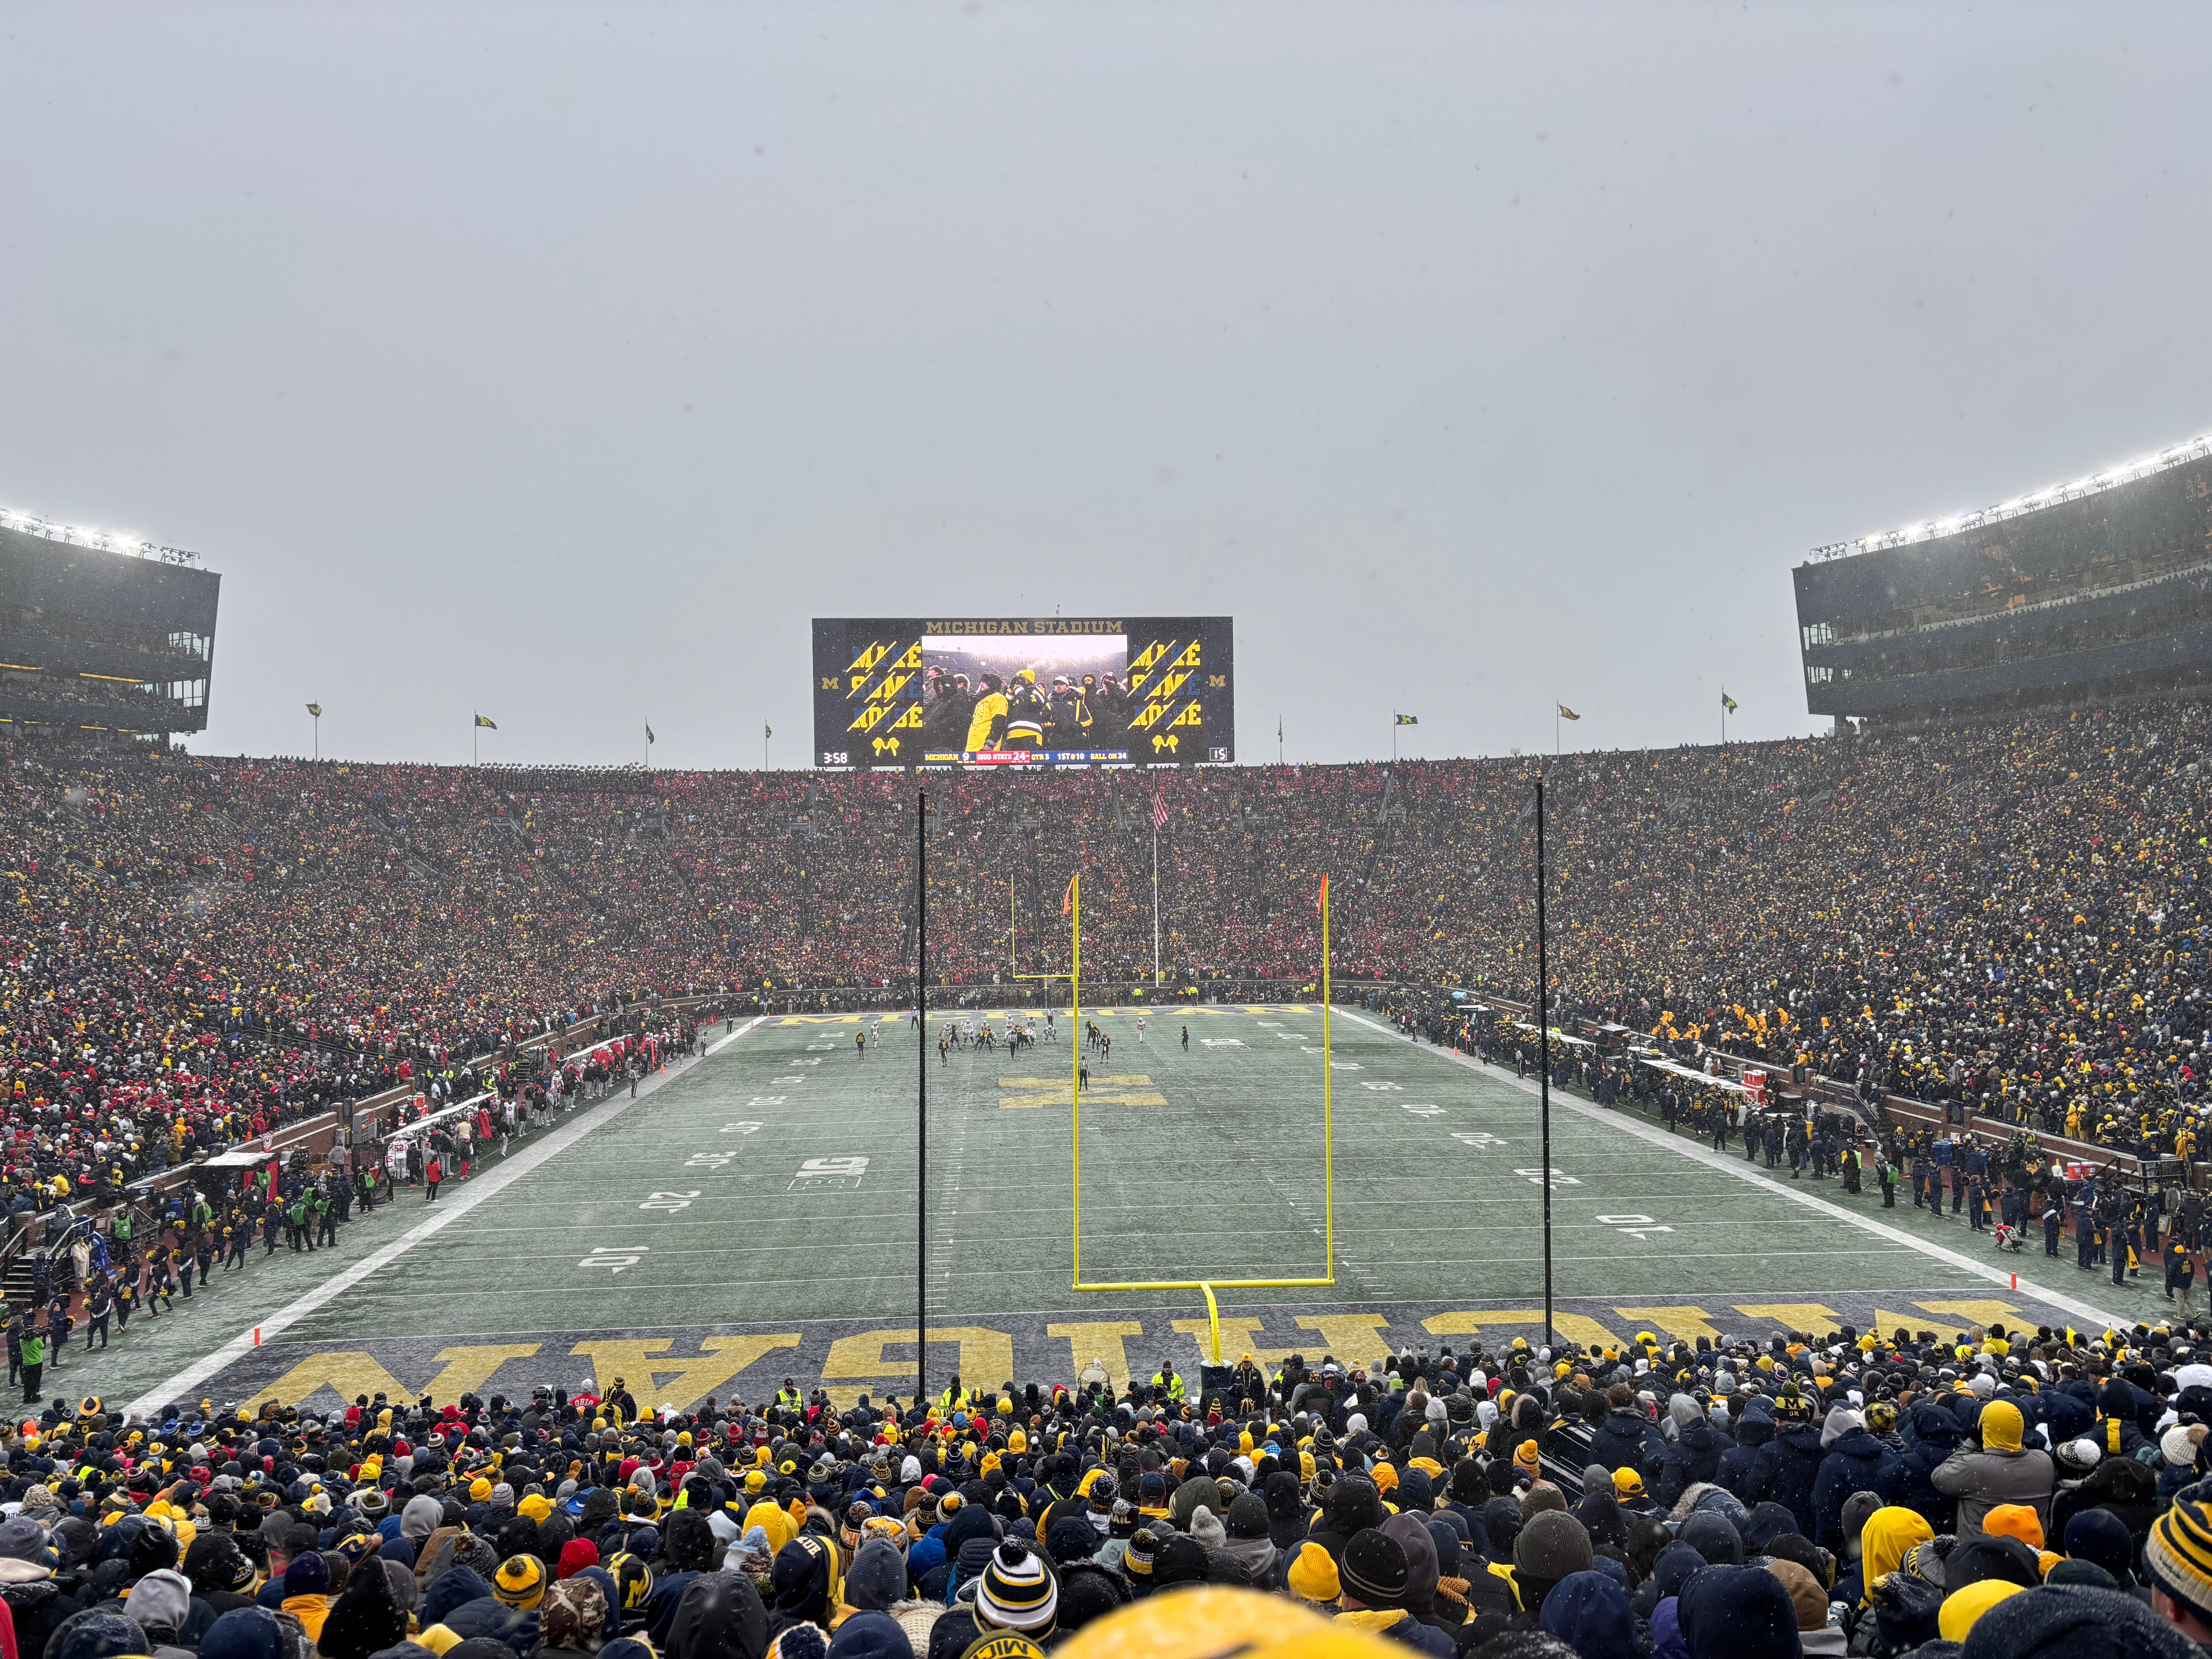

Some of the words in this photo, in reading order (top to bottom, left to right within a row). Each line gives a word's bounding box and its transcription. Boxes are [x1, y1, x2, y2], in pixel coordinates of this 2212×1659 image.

[926, 622, 1029, 633] MICHIGAN
[1034, 621, 1122, 633] STADIUM
[852, 646, 921, 668] MAKE
[1133, 644, 1200, 666] MAKE
[822, 678, 839, 689] M
[852, 676, 922, 698] SOME
[1132, 674, 1201, 696] SOME
[1209, 675, 1225, 687] M
[852, 707, 922, 728] NOISE
[1133, 704, 1201, 725] NOISE
[824, 752, 847, 764] 3:58
[962, 752, 970, 761] 9
[1214, 749, 1226, 760] 15
[770, 1006, 1316, 1025] MICHIGAN
[1360, 1082, 1404, 1090] 50
[747, 1096, 788, 1106] 50
[1401, 1104, 1448, 1114] 40
[719, 1121, 764, 1133] 40
[1449, 1132, 1508, 1145] 30
[684, 1151, 738, 1166] 30
[1513, 1168, 1584, 1184] 20
[638, 1190, 702, 1210] 20
[1595, 1214, 1676, 1234] 10
[578, 1246, 650, 1267] 10
[574, 1398, 594, 1407] OHIO
[1784, 1398, 1801, 1409] M
[450, 1476, 457, 1486] M
[624, 1580, 644, 1608] M
